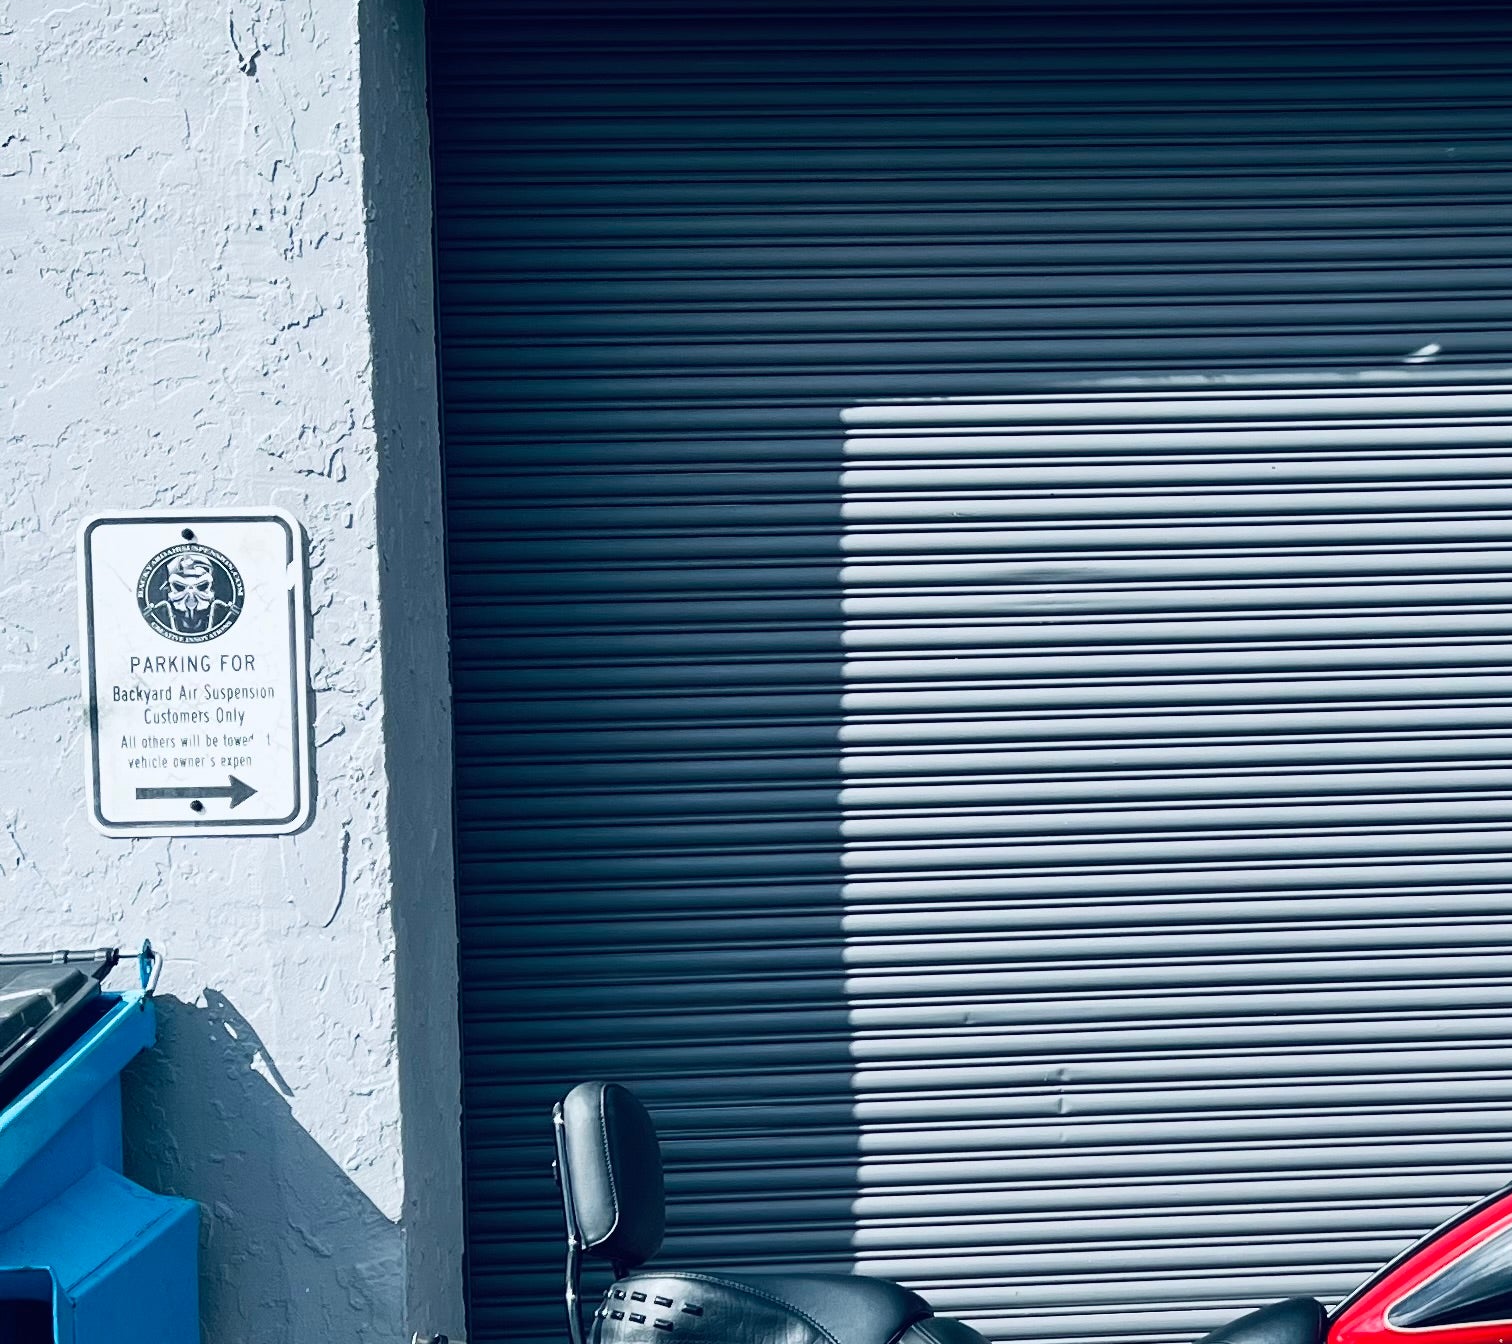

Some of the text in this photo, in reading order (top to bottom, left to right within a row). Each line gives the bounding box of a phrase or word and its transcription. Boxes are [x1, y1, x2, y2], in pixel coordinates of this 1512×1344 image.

[130, 654, 255, 674] PARKING FOR
[113, 685, 275, 704] Backyard Air Suspension
[144, 706, 245, 726] Customers Only
[121, 735, 136, 749] All
[142, 736, 176, 749] others
[181, 734, 200, 747] will
[206, 734, 219, 747] be
[128, 755, 168, 769] vehicle
